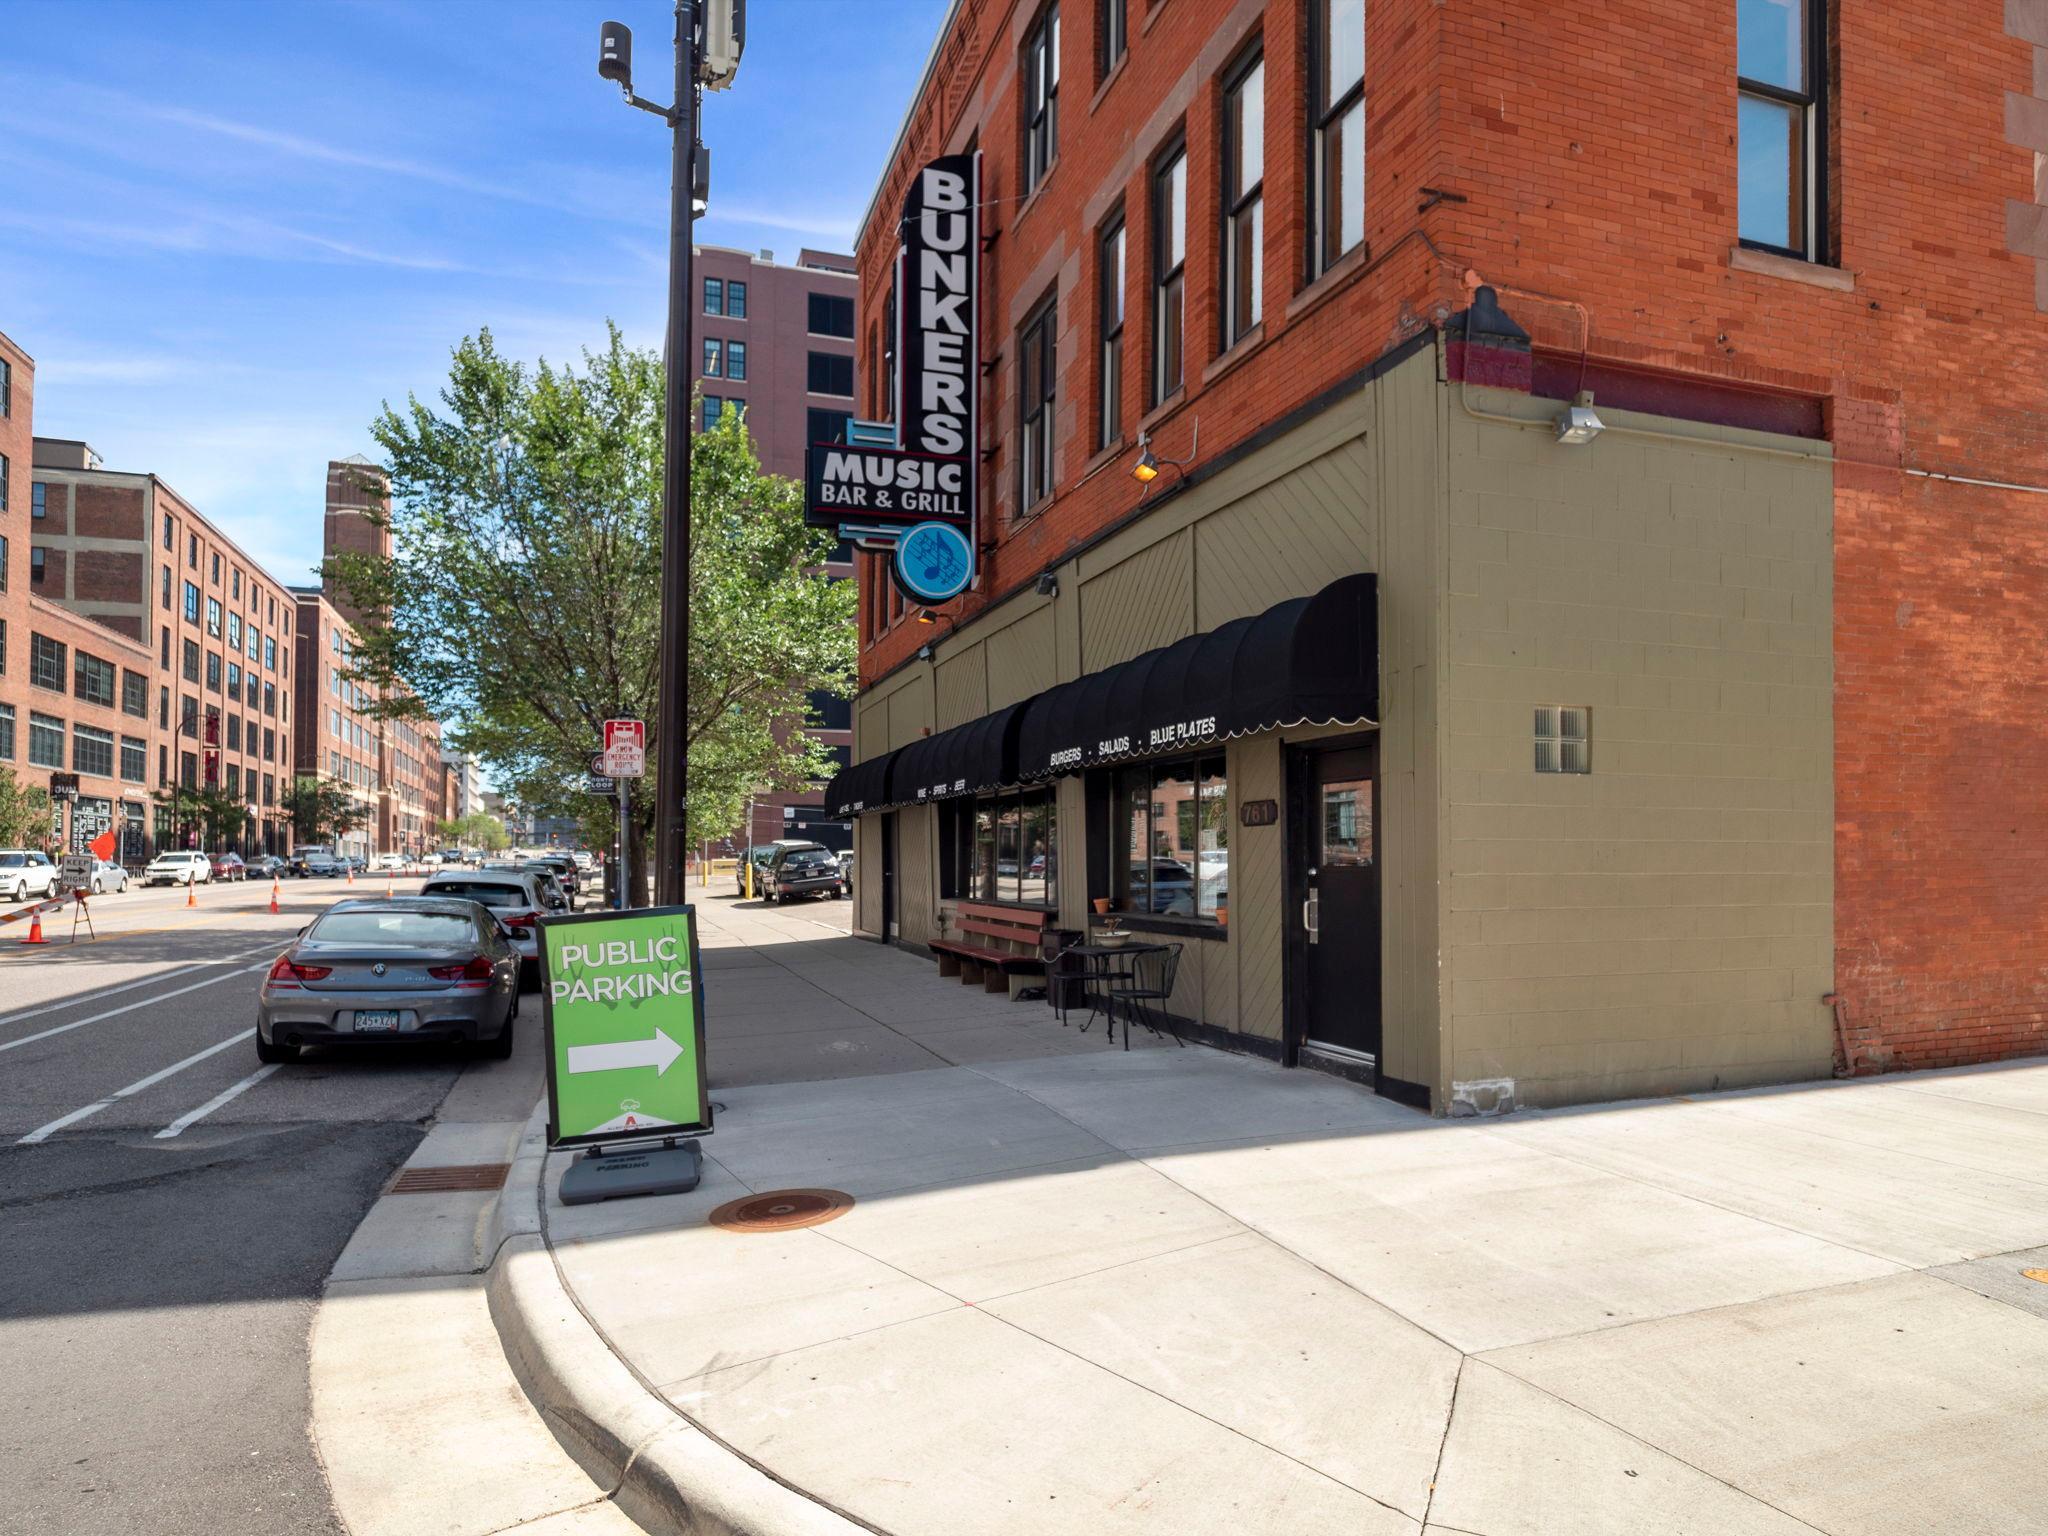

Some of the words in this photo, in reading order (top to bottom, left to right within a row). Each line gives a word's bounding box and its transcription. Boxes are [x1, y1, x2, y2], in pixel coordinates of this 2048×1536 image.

[920, 168, 969, 454] BUNKERS
[822, 452, 962, 493] MUSIC
[821, 483, 866, 507] BAR
[875, 491, 893, 508] &
[901, 491, 965, 514] GRILL
[615, 746, 633, 754] SNOW
[1050, 747, 1082, 766] BURGERS
[1099, 736, 1130, 755] SALADS
[1150, 725, 1175, 745] BLUE
[1177, 716, 1215, 739] PLATES
[64, 875, 89, 883] RIGHT
[66, 859, 90, 867] KEEP
[561, 936, 678, 970] PUBLIC
[551, 970, 692, 1006] PARKING
